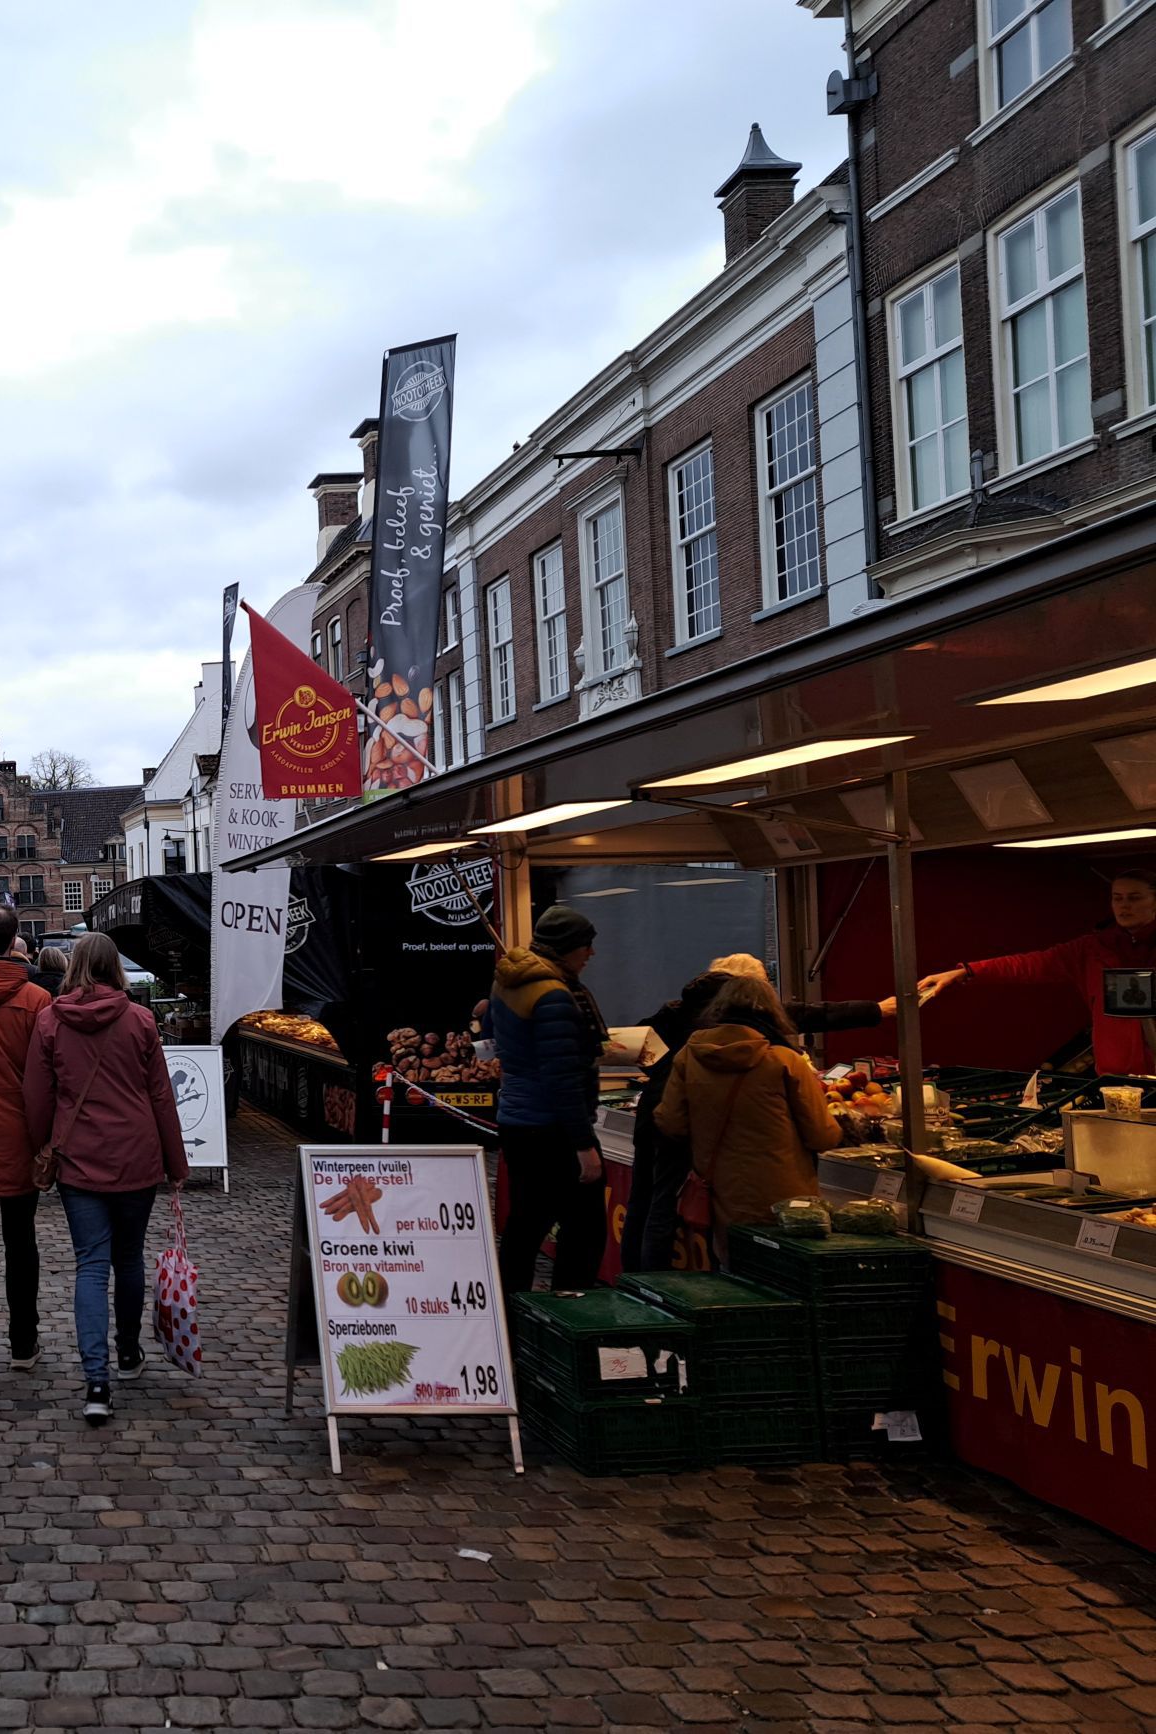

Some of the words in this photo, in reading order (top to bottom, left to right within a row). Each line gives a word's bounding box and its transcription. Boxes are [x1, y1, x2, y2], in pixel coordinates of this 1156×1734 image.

[395, 373, 446, 409] NOOTOTHEEK
[383, 486, 415, 550] beleef
[410, 544, 432, 559] &
[380, 558, 411, 626] Proef,
[262, 721, 303, 745] Erwin
[304, 707, 352, 731] Jansen
[281, 783, 344, 795] BRUMMEN
[228, 808, 238, 824] &
[241, 809, 285, 828] KOOK-
[221, 901, 283, 935] OPEN
[402, 942, 428, 952] Proef,
[430, 942, 455, 952] beleef
[471, 943, 496, 953] genie
[313, 1161, 375, 1174] Winterpeen
[378, 1160, 412, 1176] (vuile)
[314, 1173, 333, 1185] De
[396, 1219, 415, 1233] per
[418, 1217, 439, 1231] kilo
[439, 1203, 475, 1235] 0,99
[320, 1241, 378, 1256] Groene
[382, 1241, 415, 1256] kiwi
[323, 1260, 349, 1272] Bron
[352, 1263, 371, 1273] van
[374, 1260, 424, 1272] vitamine!
[405, 1297, 418, 1313] 10
[421, 1296, 450, 1314] stuks
[450, 1281, 487, 1316] 4,49
[328, 1319, 397, 1339] Sperziebonen
[415, 1383, 432, 1398] 500
[460, 1365, 499, 1401] 1,98
